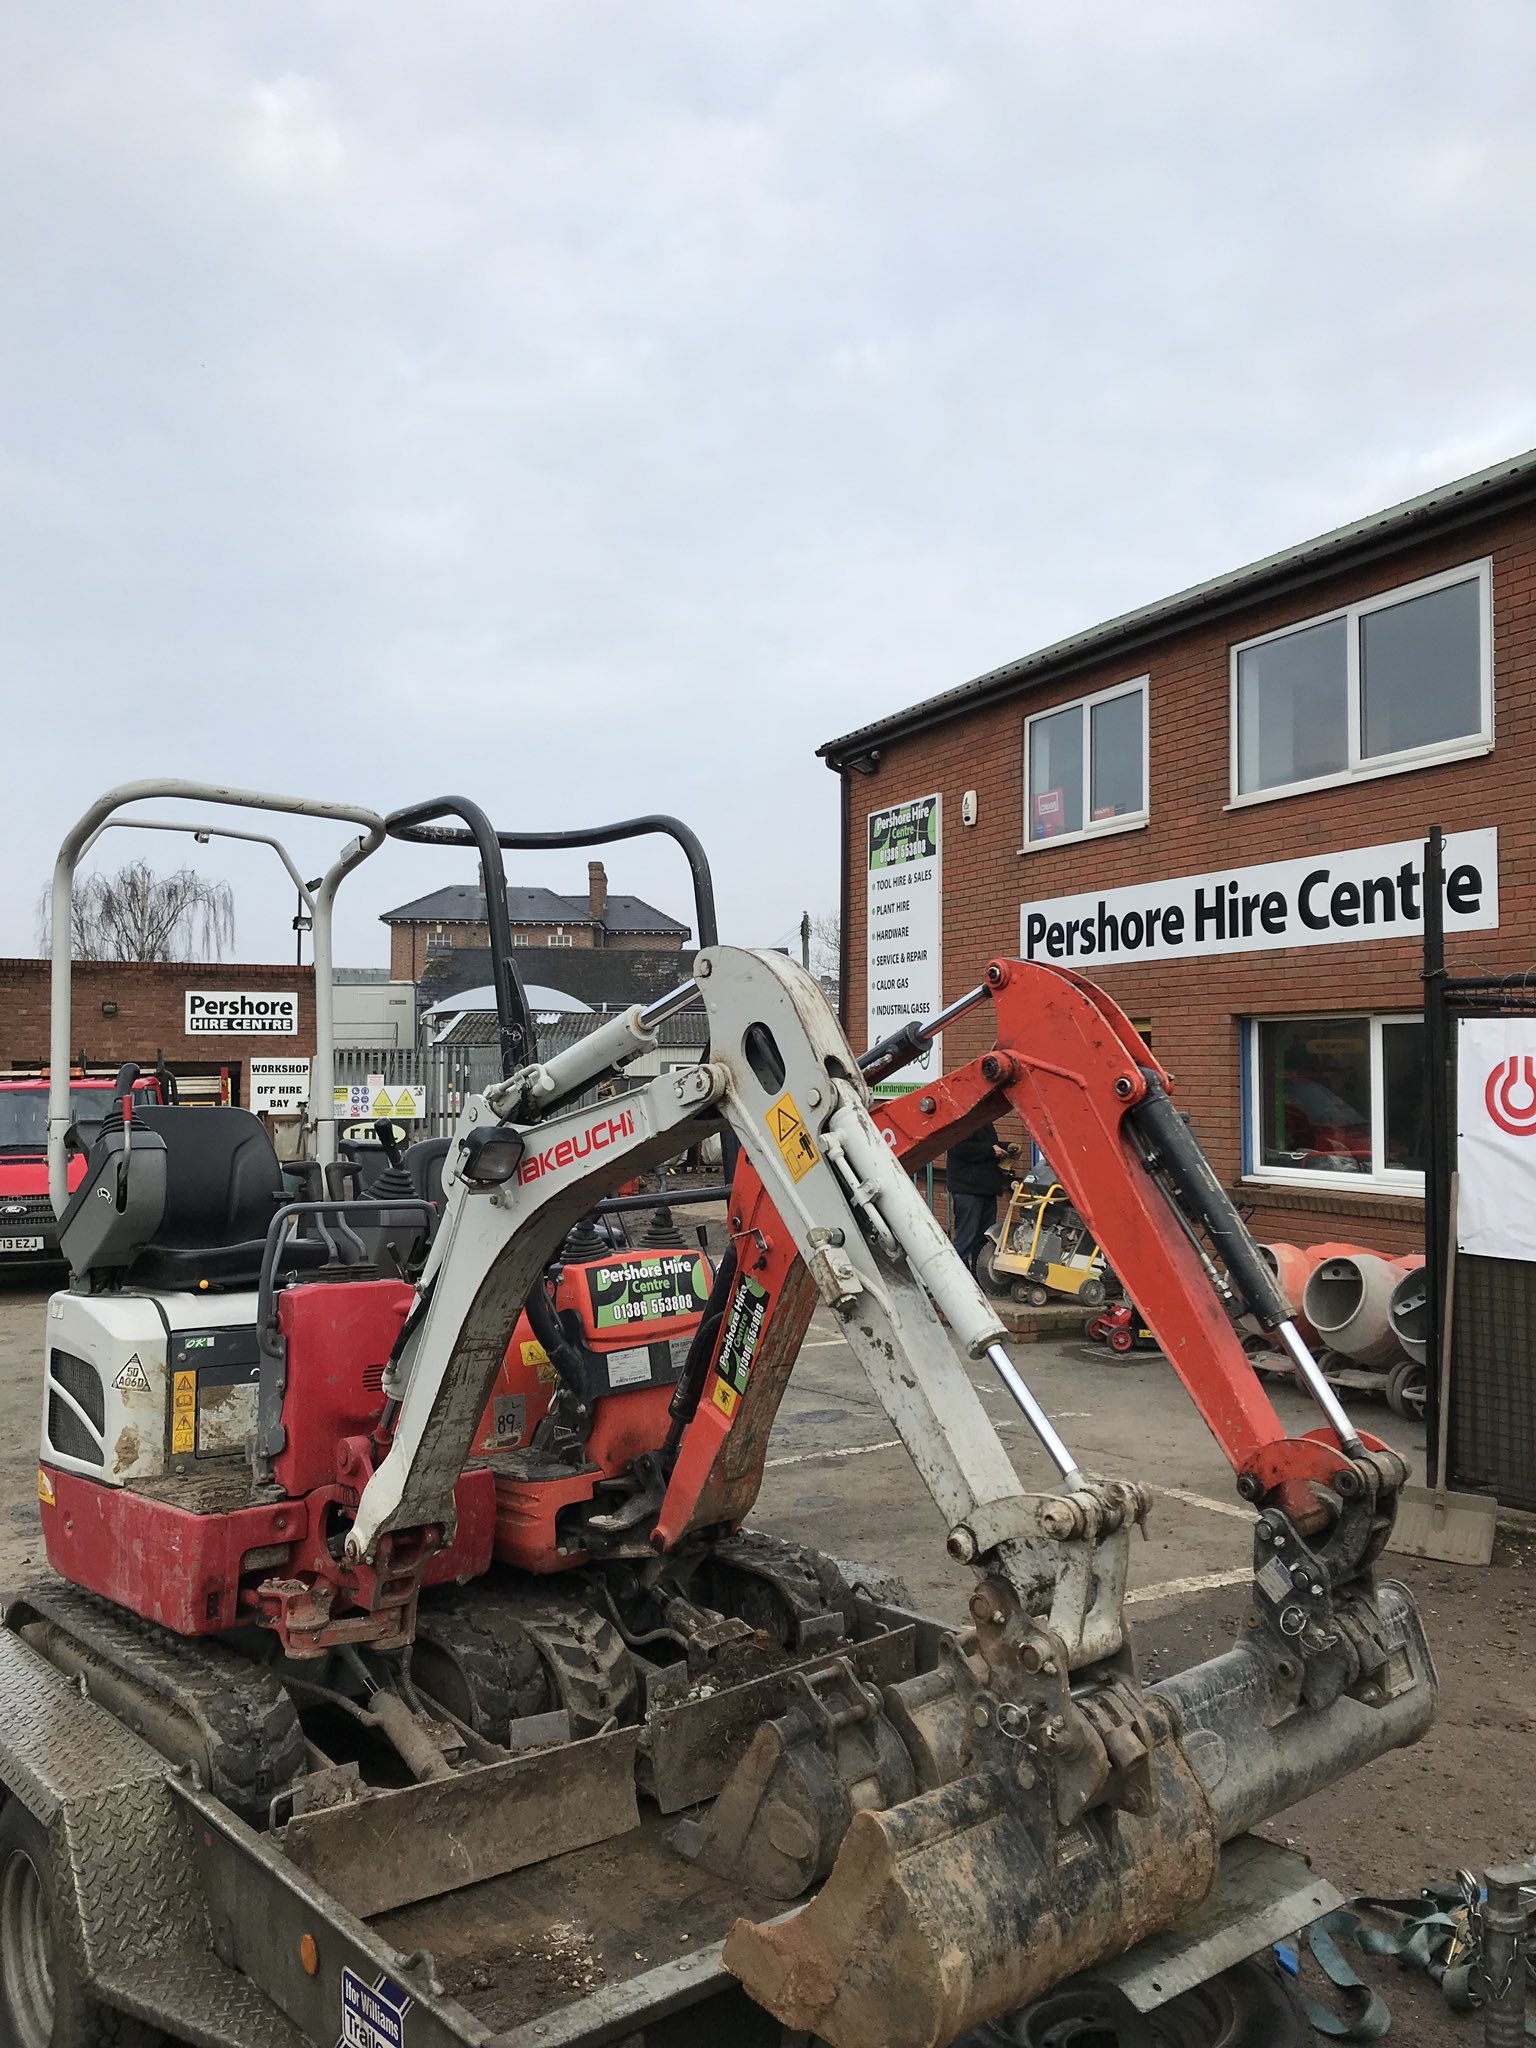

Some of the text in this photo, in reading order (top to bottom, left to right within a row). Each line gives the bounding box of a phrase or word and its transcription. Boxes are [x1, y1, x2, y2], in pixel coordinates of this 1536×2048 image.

[876, 805, 929, 831] Pershore Hire
[891, 825, 915, 840] Centre
[877, 869, 932, 891] TOOL HIRE & SALES
[877, 900, 910, 916] PLANT HIRE
[1027, 861, 1483, 959] Pershore Hire Cente
[876, 926, 909, 941] HARDWARE
[876, 950, 928, 966] SERVICE & REPAIR
[876, 977, 909, 991] CALOR GAS
[190, 995, 293, 1015] Pershore
[876, 1002, 930, 1016] INDUSTRIAL GASES
[192, 1019, 291, 1030] HIRE CENTRE
[251, 1064, 309, 1073] WORKSHOP
[257, 1086, 302, 1094] OFF HIRE
[269, 1099, 289, 1107] BAY
[16, 1238, 37, 1248] EZJ
[600, 1258, 692, 1284] Pershore Hire
[632, 1276, 670, 1293] Centre
[613, 1294, 693, 1320] 01386 553808
[719, 1284, 748, 1367] Pershore Hire
[733, 1313, 748, 1348] Centre
[738, 1343, 753, 1378] 01386
[497, 1414, 515, 1434] 89
[345, 1978, 399, 2041] Ifor Williams
